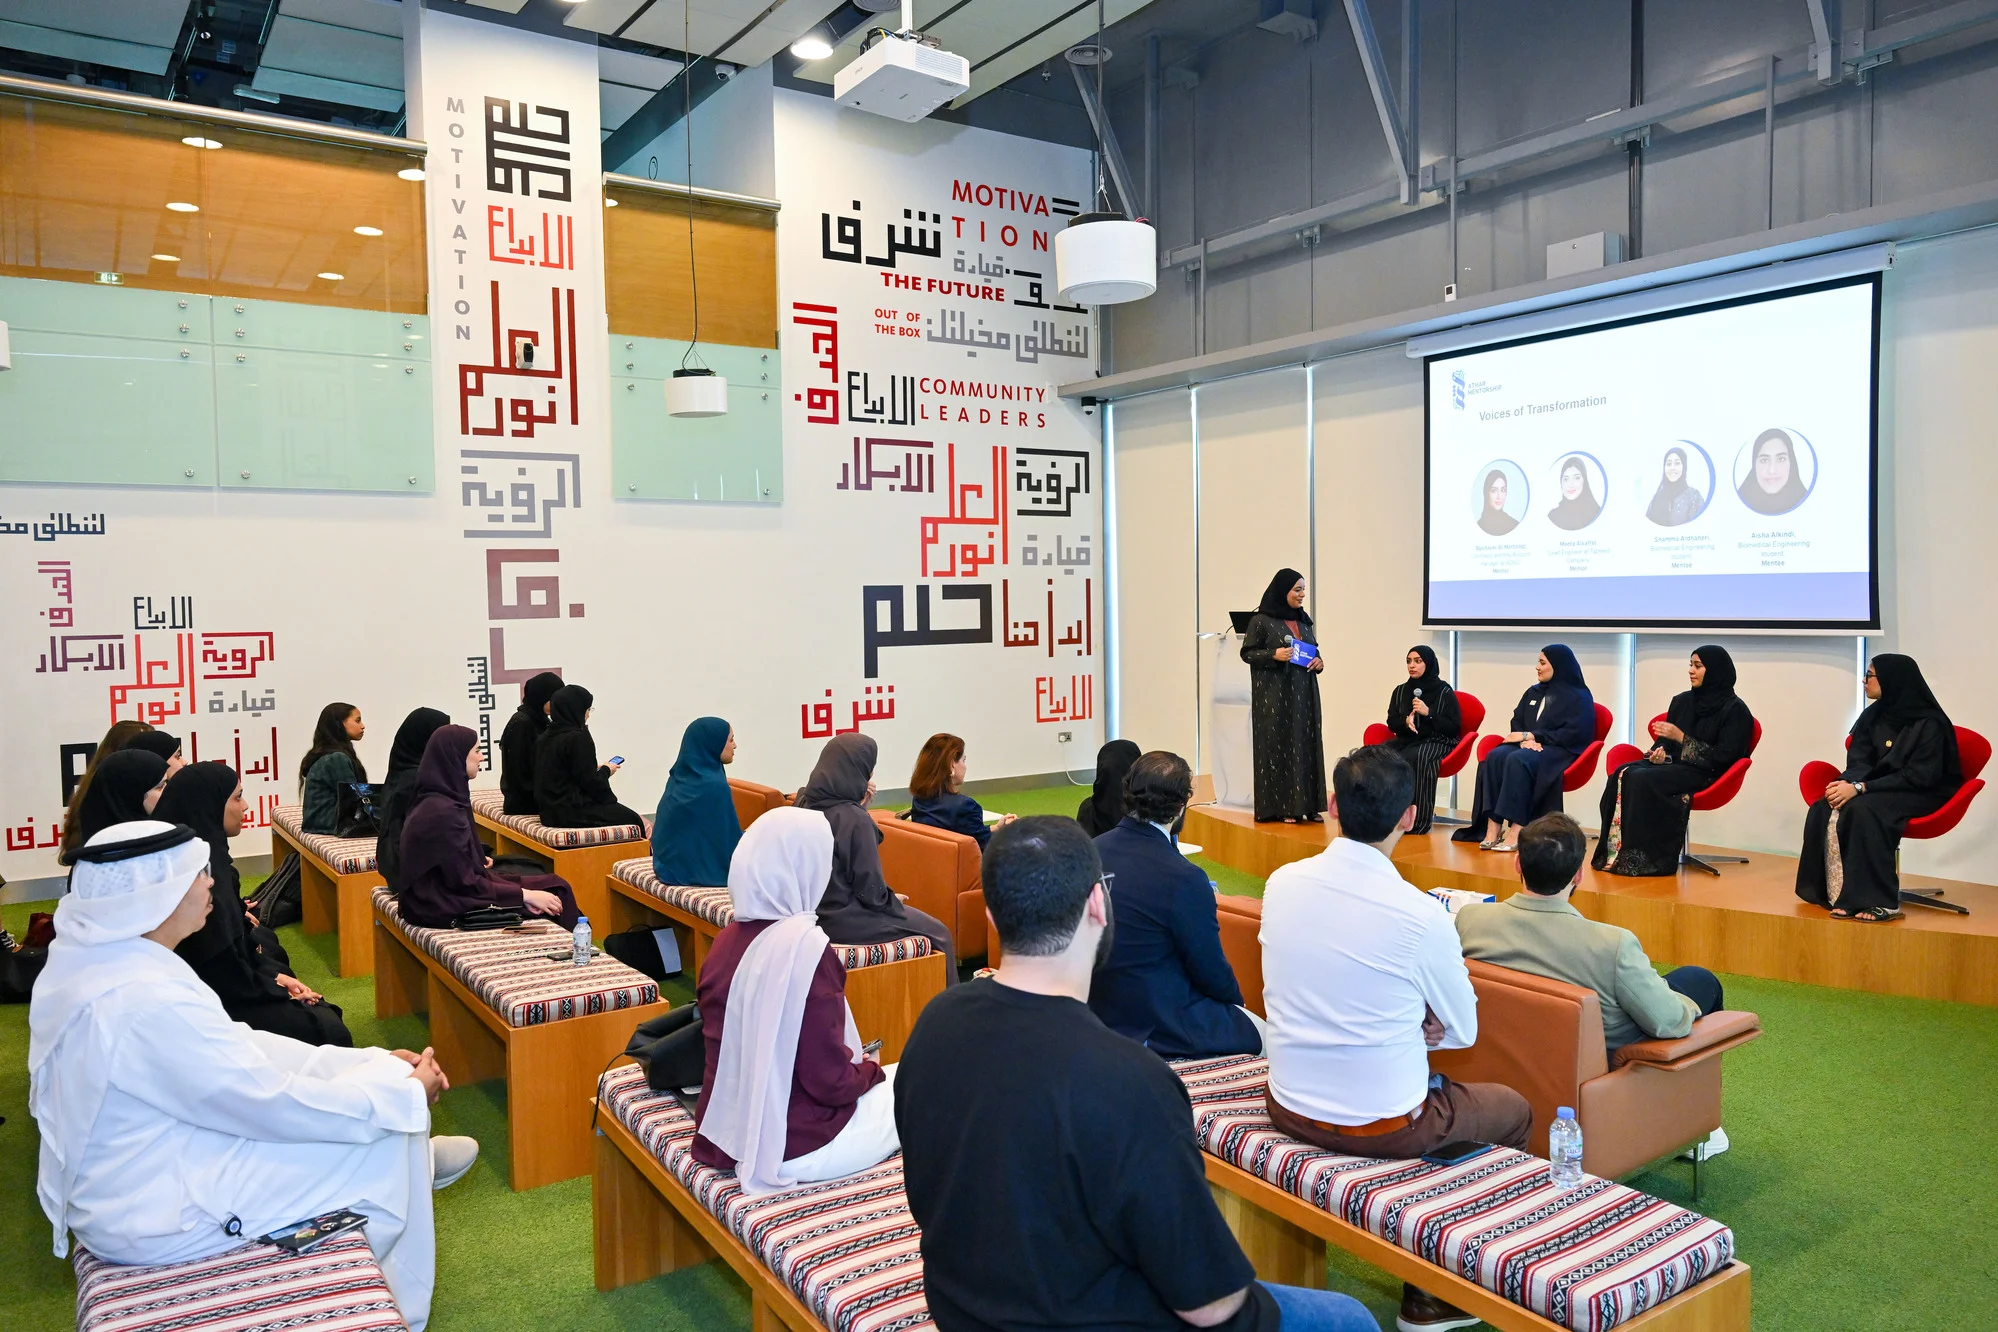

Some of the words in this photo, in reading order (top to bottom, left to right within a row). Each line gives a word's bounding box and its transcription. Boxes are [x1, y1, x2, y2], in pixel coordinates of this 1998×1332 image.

[952, 179, 1050, 217] MOTIVA
[447, 97, 471, 340] MOTIVATION
[880, 271, 922, 292] THE
[927, 278, 1005, 302] FUTURE
[874, 308, 898, 320] OUT
[906, 311, 921, 323] OF
[874, 323, 896, 336] THE
[899, 326, 921, 338] BOX
[919, 377, 1046, 403] COMMUNITY
[920, 403, 1047, 428] LEADERS
[1479, 409, 1511, 421] Voices
[1513, 406, 1524, 417] of
[1527, 396, 1607, 415] Transformation
